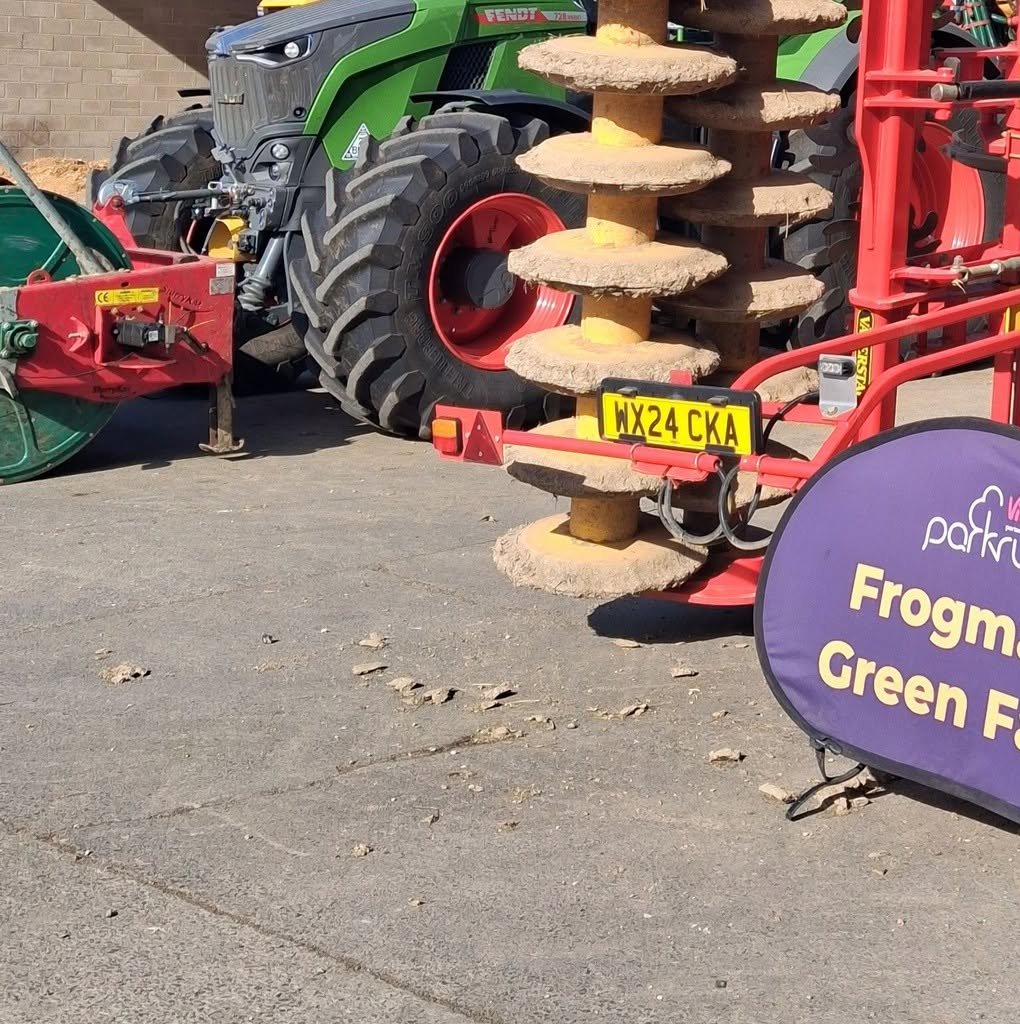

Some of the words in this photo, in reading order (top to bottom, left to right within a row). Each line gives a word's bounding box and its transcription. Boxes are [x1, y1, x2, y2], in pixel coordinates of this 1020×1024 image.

[484, 7, 538, 23] FENDT
[614, 400, 679, 440] WX24
[687, 409, 739, 447] CKA
[817, 639, 969, 729] Green
